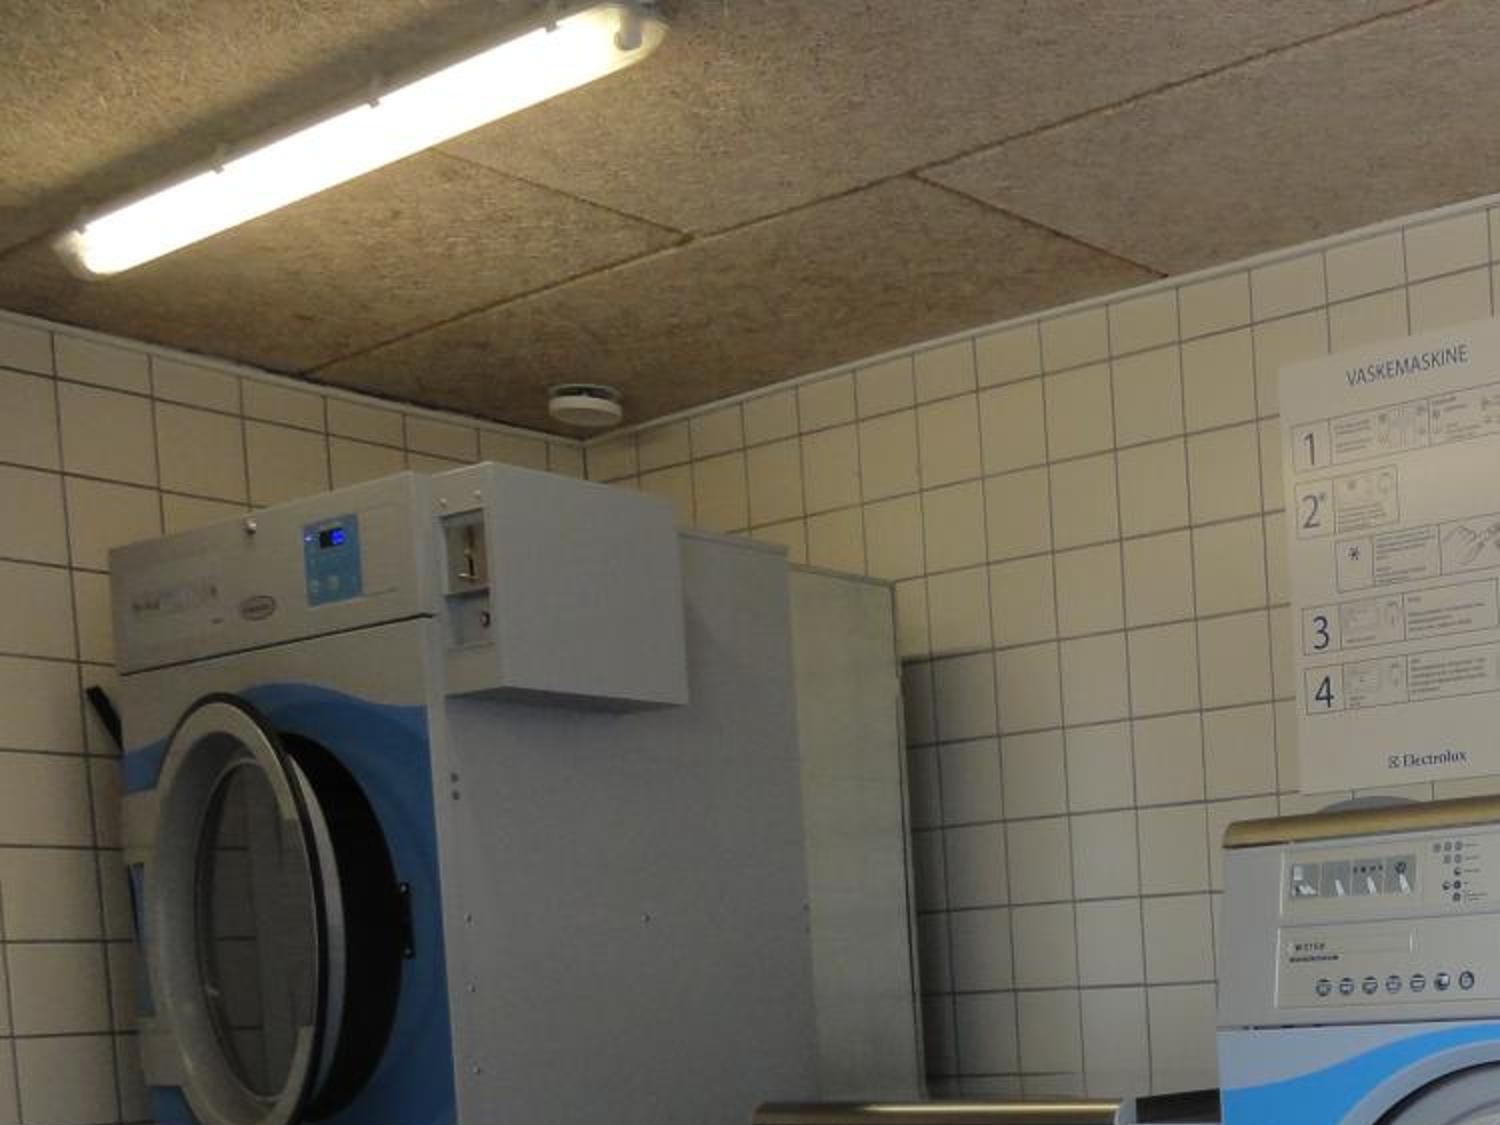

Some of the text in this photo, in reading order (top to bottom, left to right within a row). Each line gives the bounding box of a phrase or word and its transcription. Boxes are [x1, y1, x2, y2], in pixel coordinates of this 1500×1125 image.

[1346, 344, 1469, 385] VASKEMASKINE
[1303, 433, 1315, 465] 1
[1312, 616, 1330, 650] 3
[1314, 676, 1335, 708] 4
[1402, 748, 1467, 769] Electrolux
